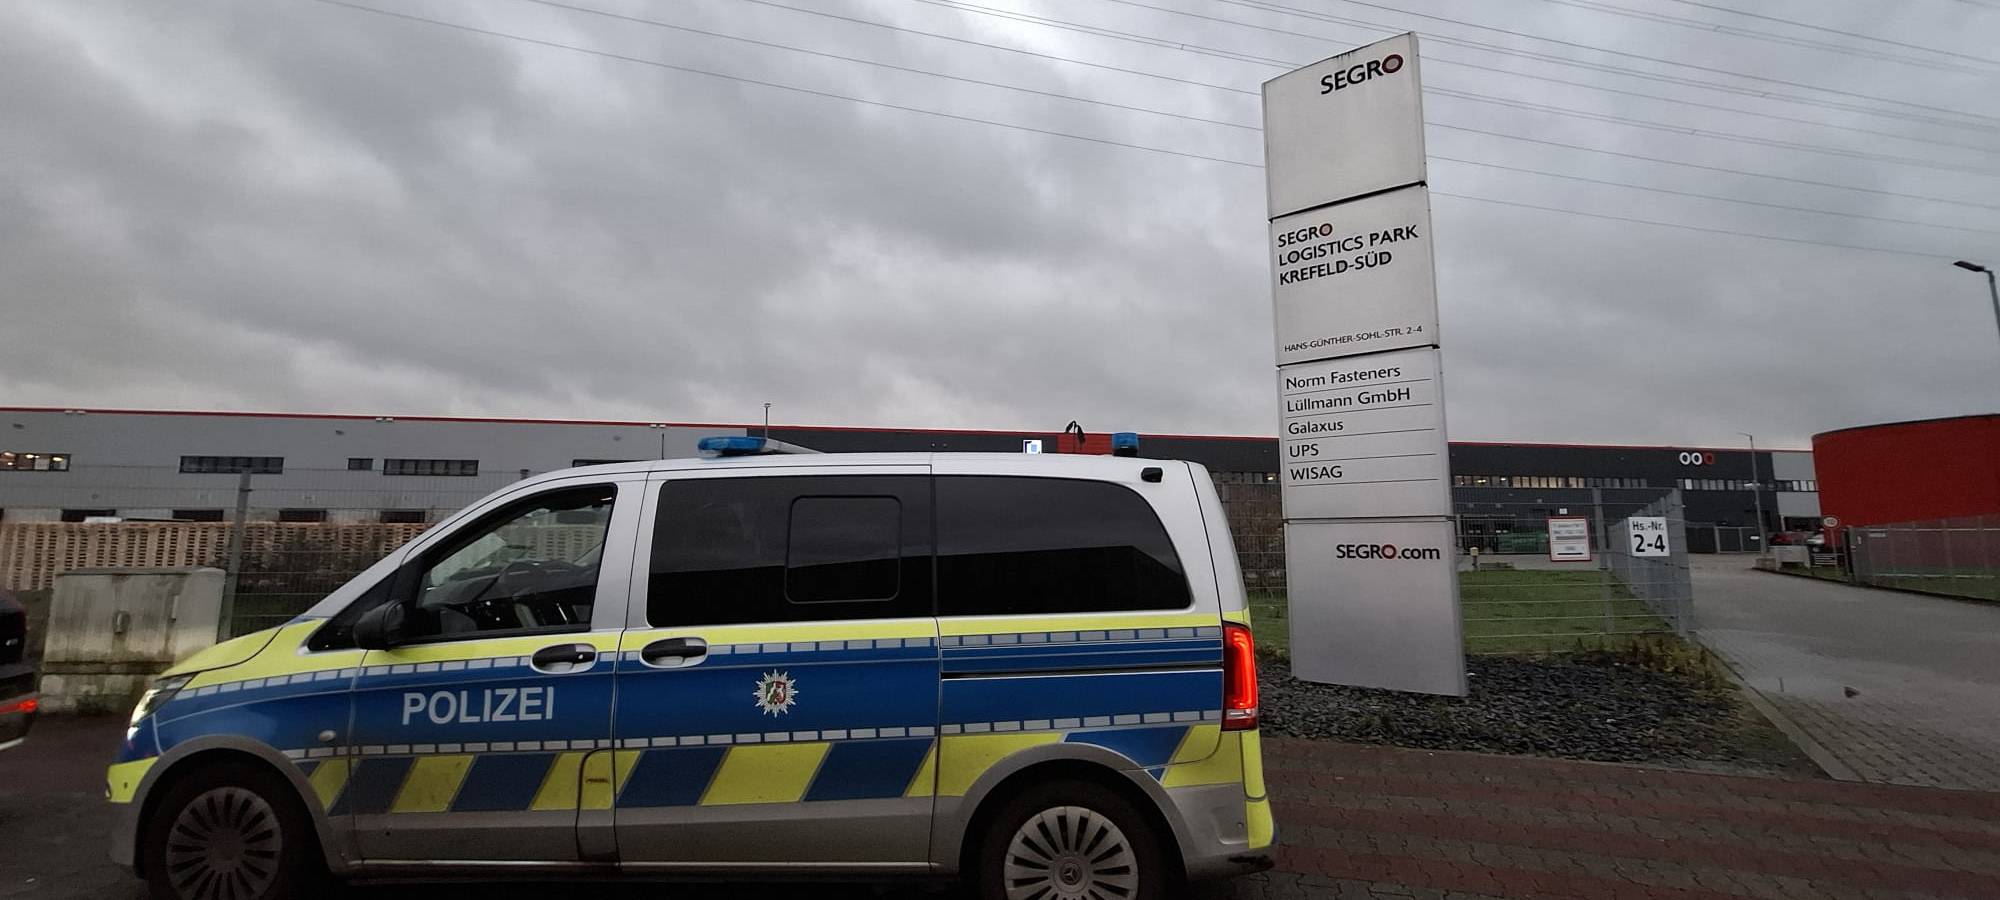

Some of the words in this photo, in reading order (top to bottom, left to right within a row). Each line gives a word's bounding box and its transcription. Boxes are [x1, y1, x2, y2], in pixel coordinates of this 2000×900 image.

[1320, 53, 1404, 95] SEGRO
[1278, 223, 1333, 248] SEGRO
[1279, 236, 1364, 266] LOGISTICS
[1369, 225, 1419, 246] PARK
[1280, 251, 1392, 286] KREFELD-SÜD
[1286, 374, 1326, 390] Norm
[1330, 366, 1401, 384] Fasteners
[1287, 396, 1353, 412] Lüllmann
[1357, 387, 1411, 405] GmbH
[1288, 420, 1344, 435] Galaxus
[1289, 443, 1320, 458] UPS
[1290, 465, 1343, 481] WISAG
[1336, 544, 1441, 560] SEGRO.com
[1633, 533, 1666, 553] 2-4
[402, 686, 555, 725] POLIZEI
